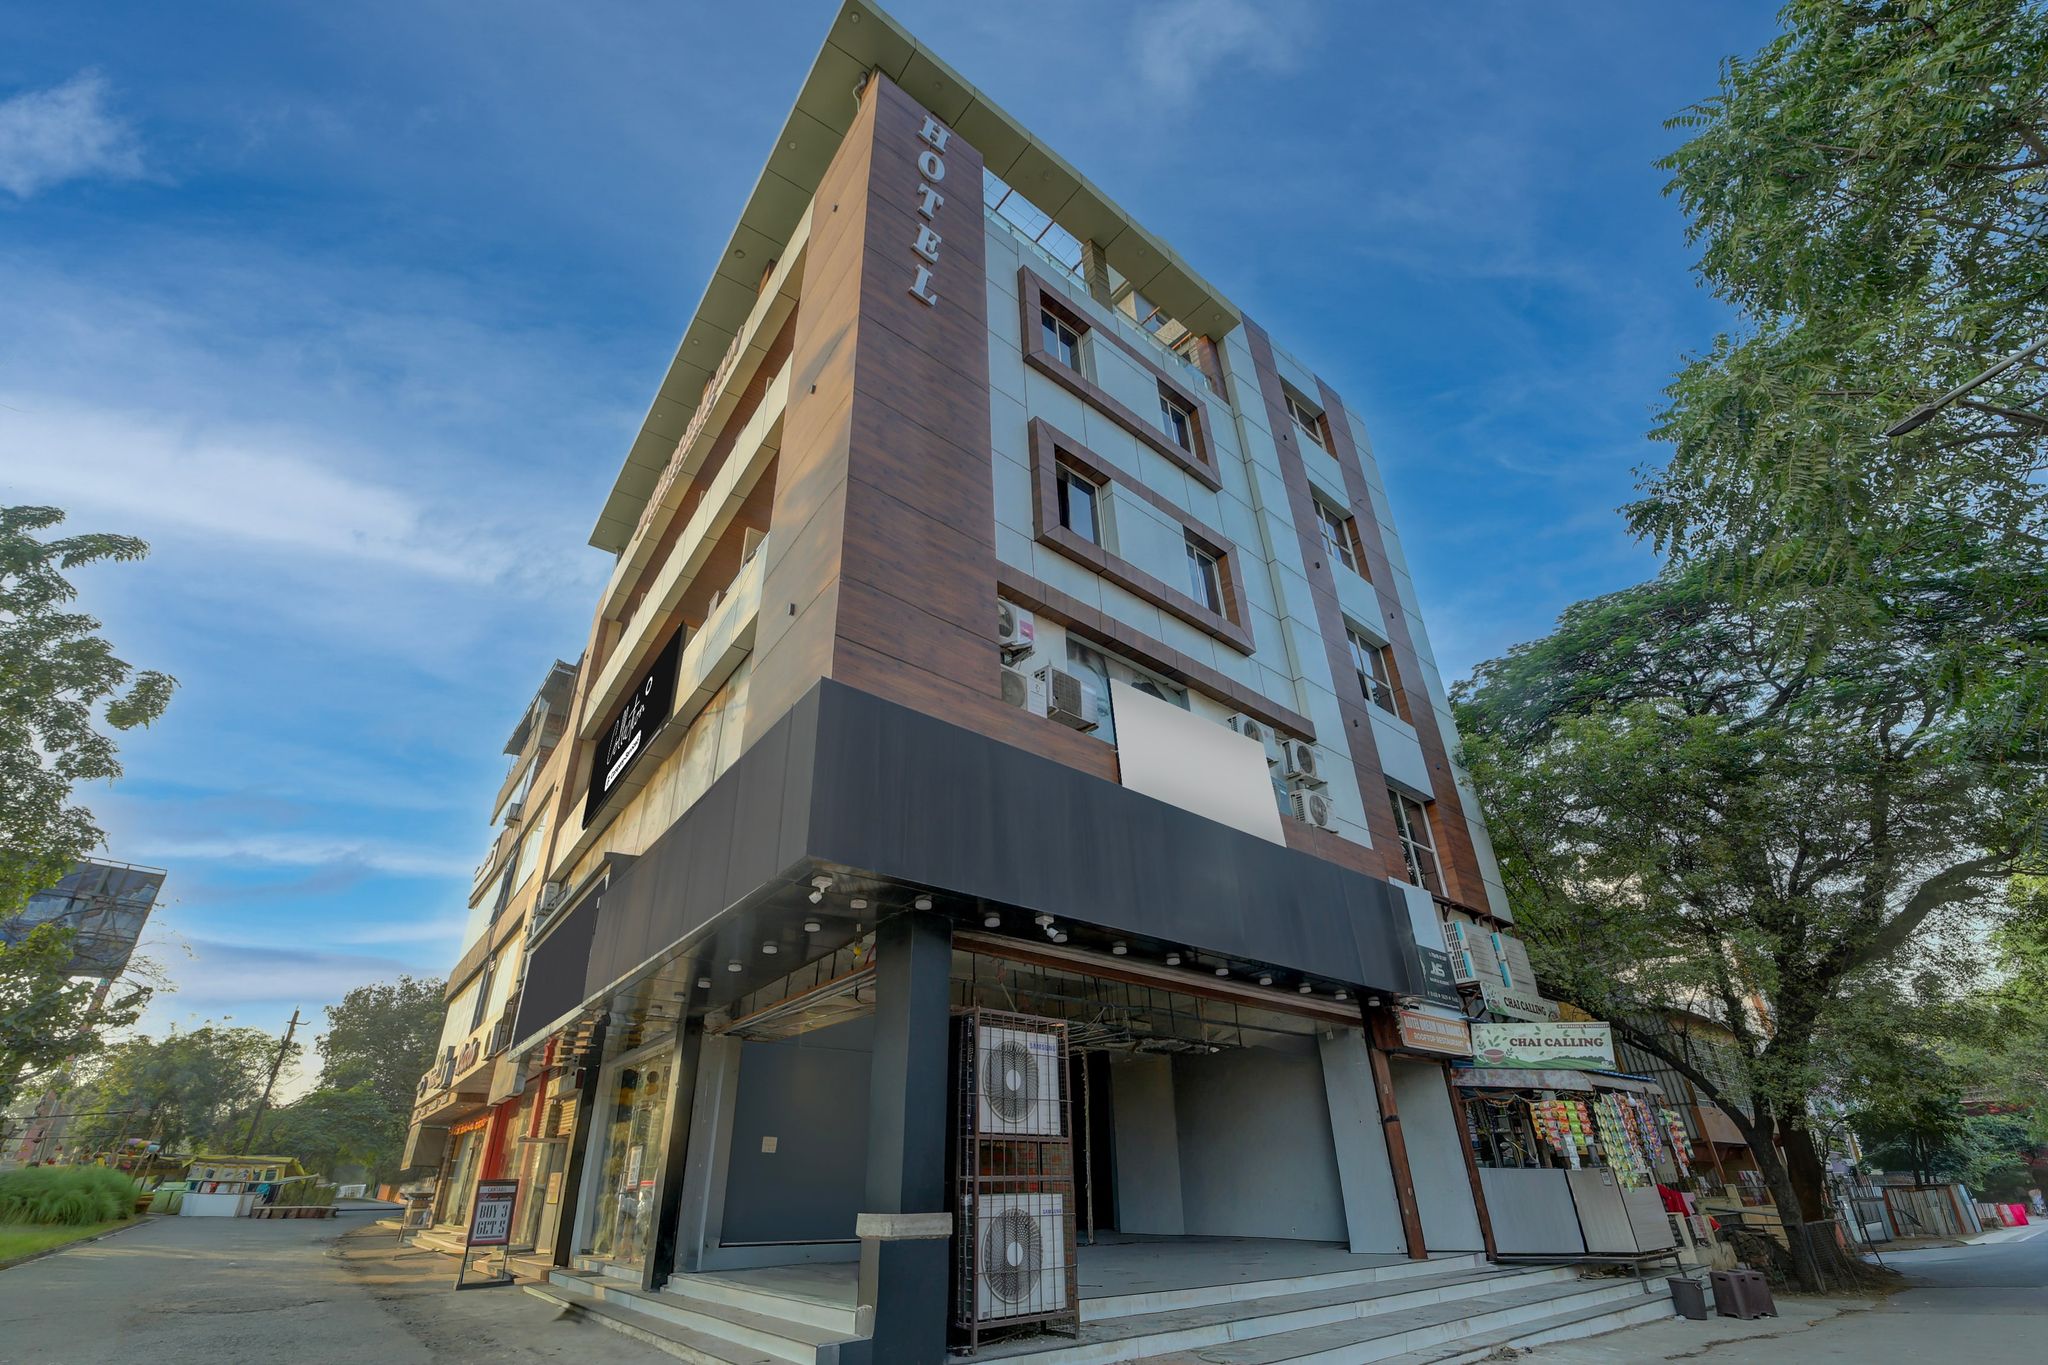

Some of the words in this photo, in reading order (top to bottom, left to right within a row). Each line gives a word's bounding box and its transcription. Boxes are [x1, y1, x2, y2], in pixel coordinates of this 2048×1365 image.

[907, 115, 951, 307] HOTEL
[1503, 996, 1521, 1010] CHAI
[1521, 1000, 1547, 1016] CALLING
[1029, 1042, 1056, 1052] SAMSUNG
[1509, 1038, 1541, 1047] CHAI
[1544, 1037, 1604, 1047] CALLING
[479, 1204, 497, 1218] BUY
[501, 1204, 508, 1218] 3
[476, 1221, 497, 1235] GET
[498, 1220, 506, 1234] 5
